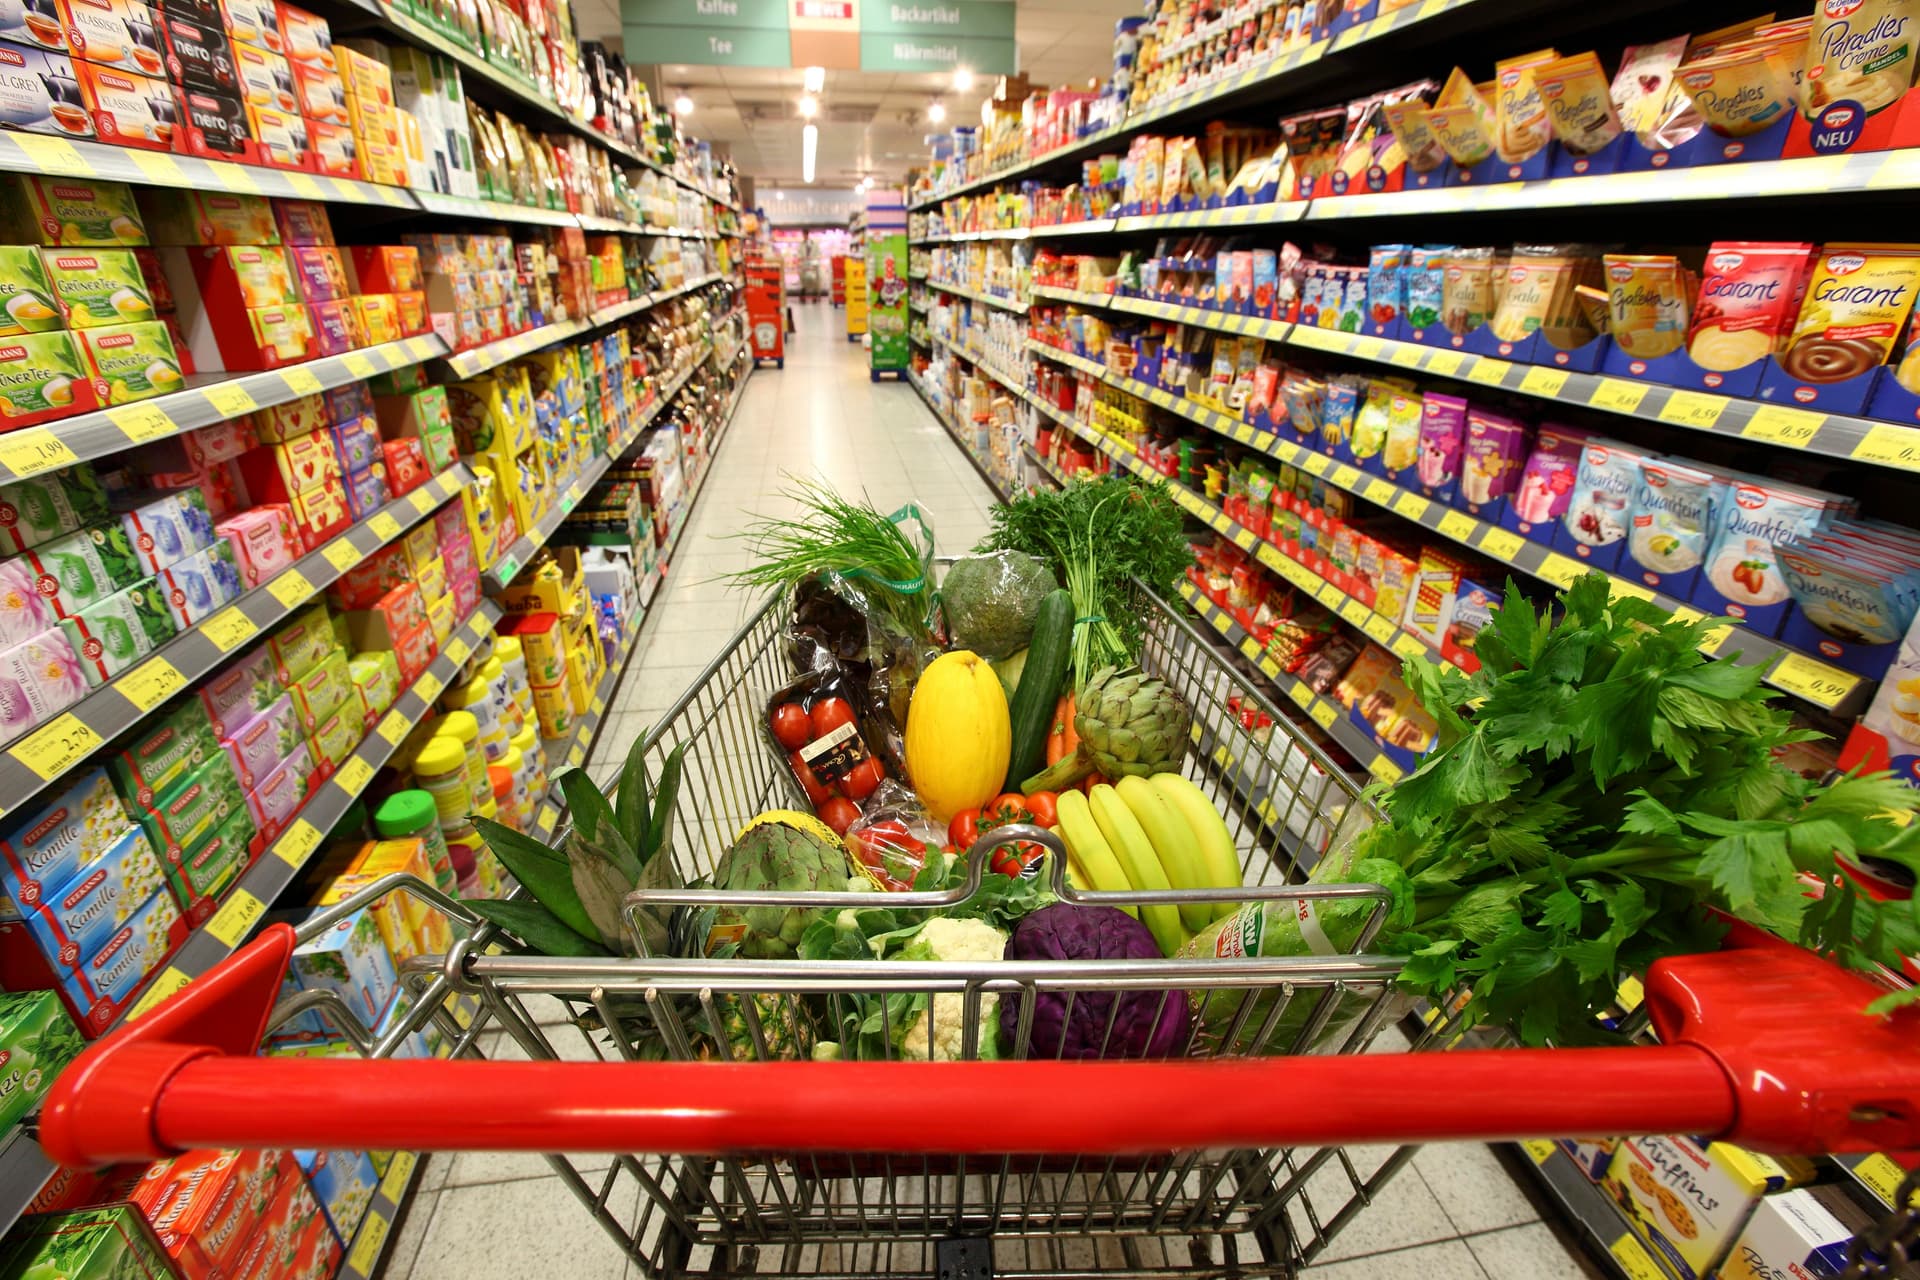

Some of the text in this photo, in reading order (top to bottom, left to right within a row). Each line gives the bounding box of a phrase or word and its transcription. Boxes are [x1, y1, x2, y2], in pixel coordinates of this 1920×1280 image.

[890, 6, 960, 24] Backartikel
[175, 39, 210, 62] nero
[708, 37, 733, 55] Tee
[1819, 13, 1910, 63] Paradies
[893, 43, 958, 61] Nährmittel
[1839, 43, 1890, 71] Creme
[11, 77, 39, 93] GREY
[1693, 85, 1765, 117] Paradies
[192, 112, 227, 131] nero
[1815, 129, 1854, 149] NEU
[1704, 275, 1781, 302] Garant
[1814, 278, 1907, 308] Garant
[1779, 425, 1813, 440] 0,59
[35, 440, 65, 460] 1,99
[12, 659, 43, 715] Innere Ruhe
[1810, 679, 1846, 697] 0,99
[61, 726, 90, 752] 2,79
[25, 825, 80, 873] Kamille
[65, 886, 118, 937] Kamille
[239, 898, 258, 921] 1,69
[94, 943, 145, 993] Kamille
[1637, 1136, 1720, 1212] Muffins
[155, 1161, 211, 1232] Hagebutte
[208, 1167, 261, 1255] Hagebutte
